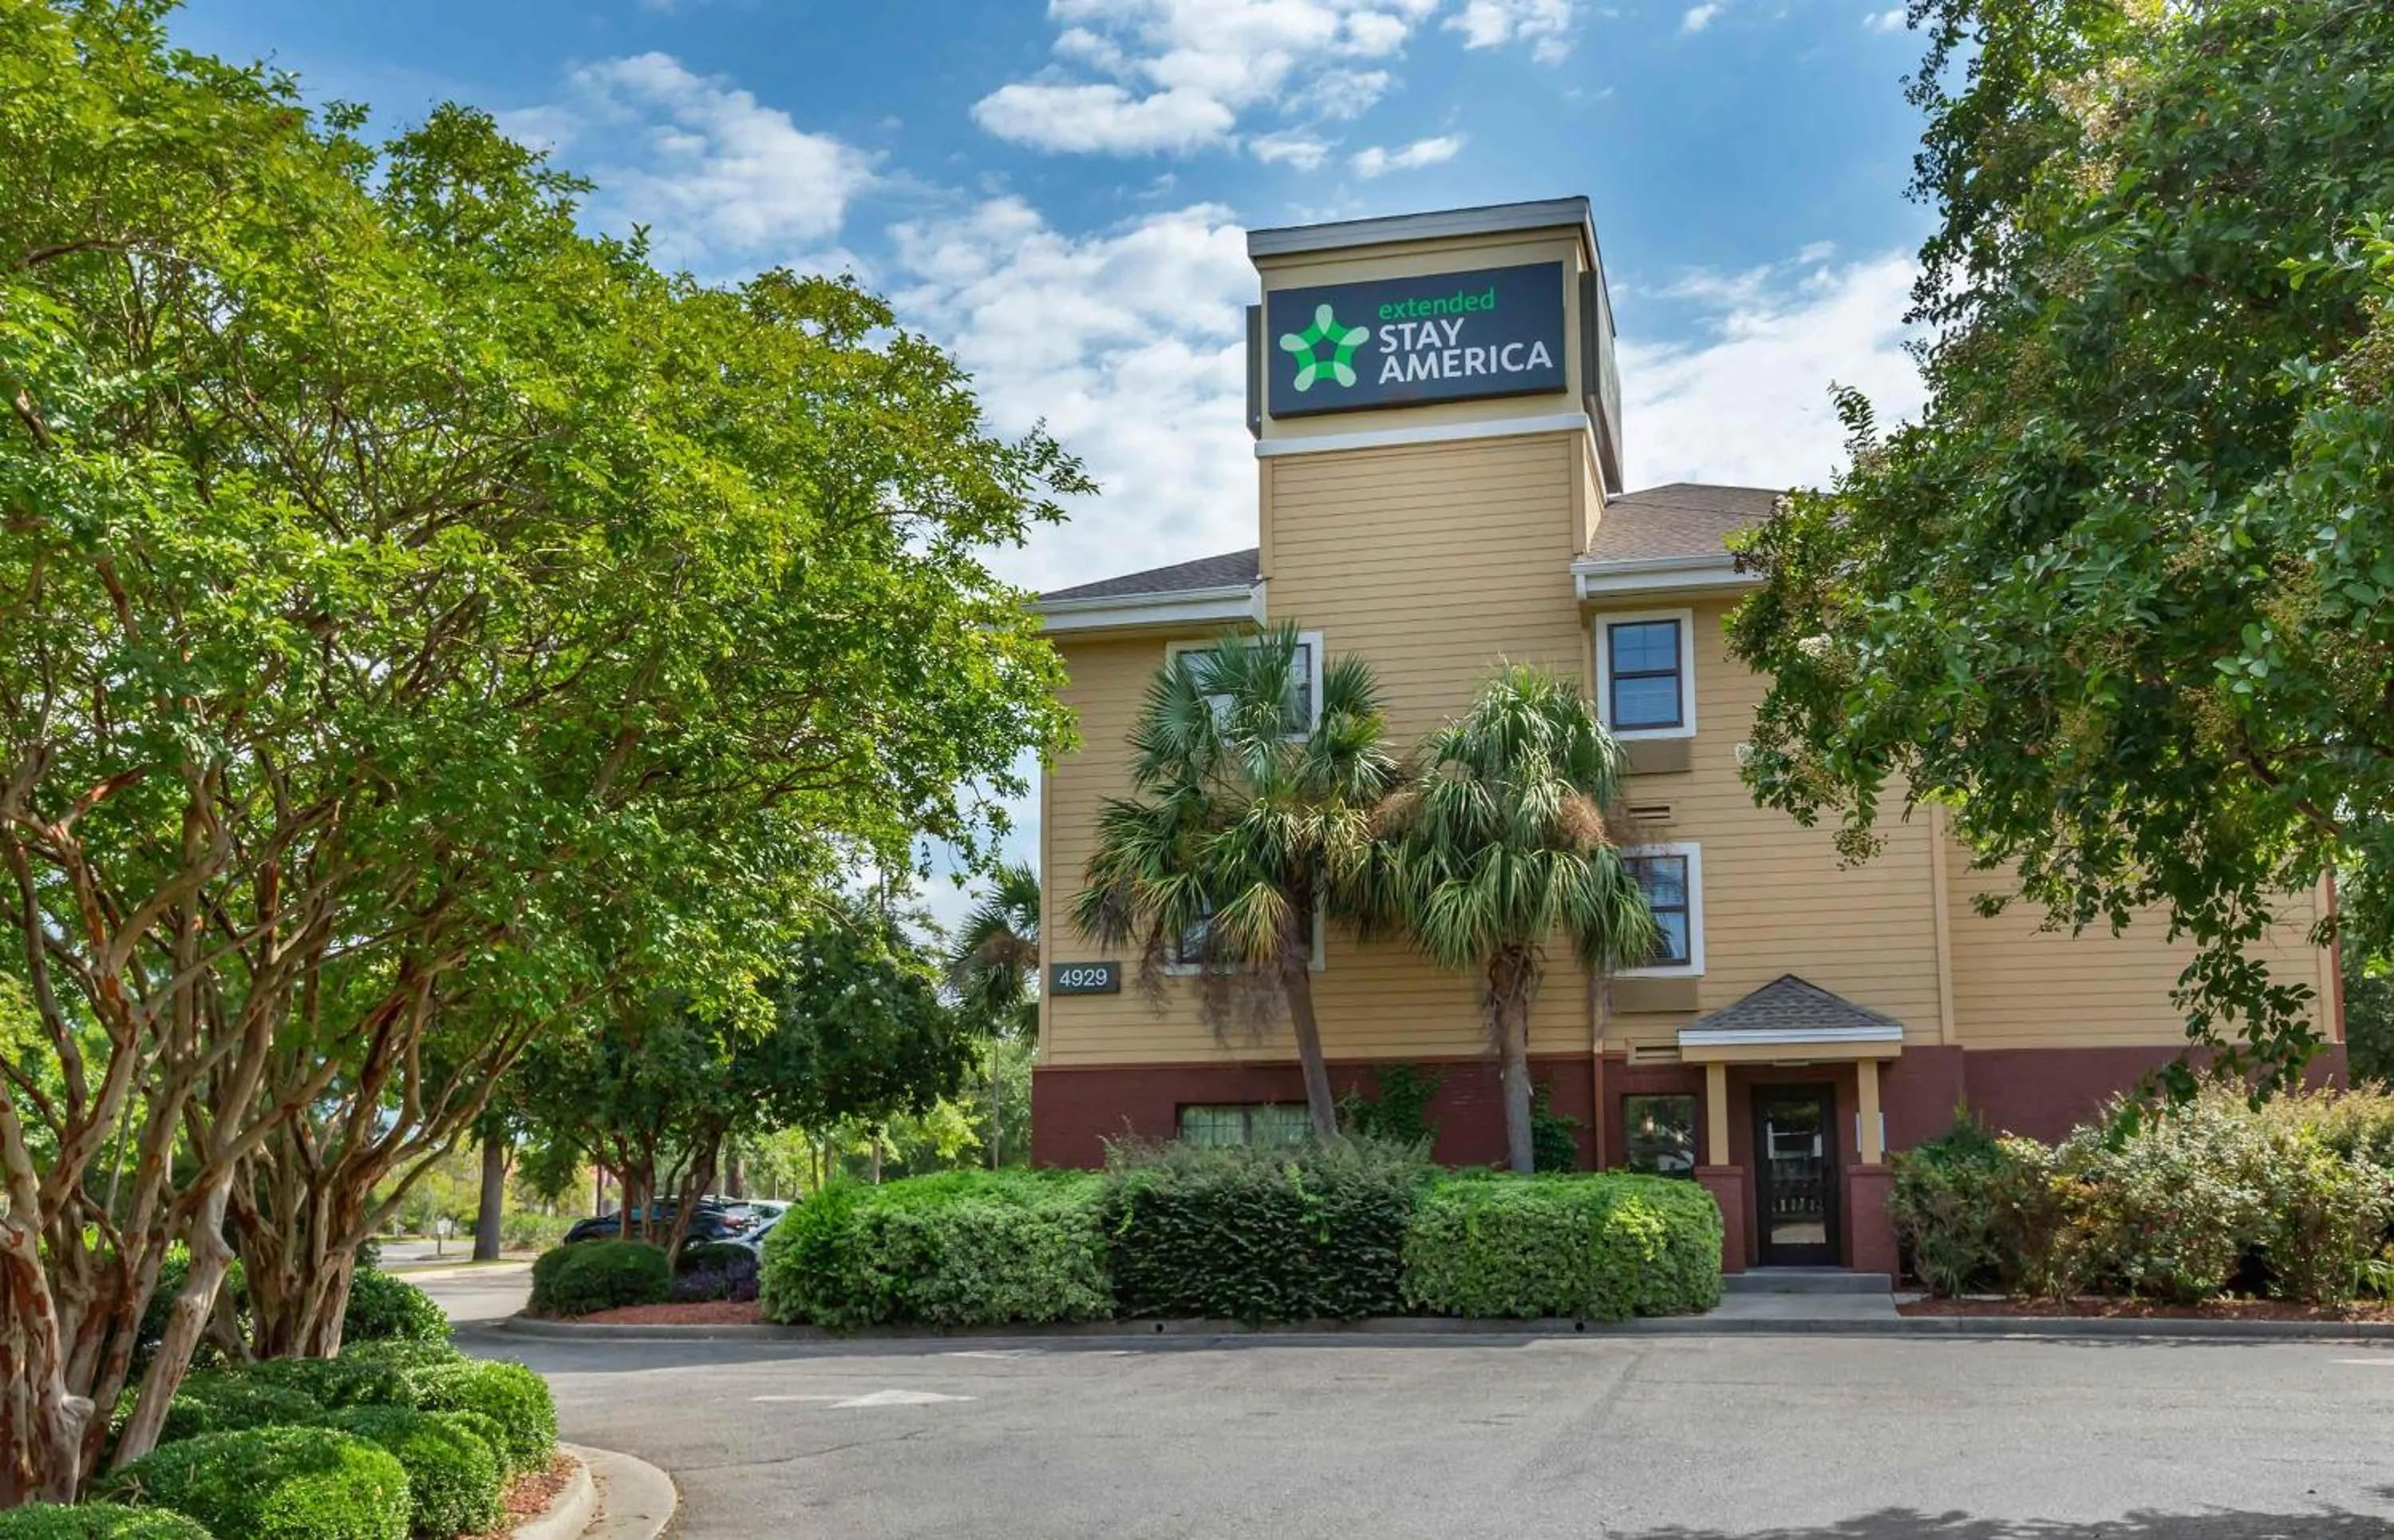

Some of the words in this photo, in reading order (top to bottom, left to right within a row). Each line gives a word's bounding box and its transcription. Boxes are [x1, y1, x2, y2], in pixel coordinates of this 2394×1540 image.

[1379, 288, 1495, 319] extended
[1379, 318, 1464, 353] STAY
[1379, 342, 1553, 384] AMERICA
[1059, 968, 1108, 987] 4929
